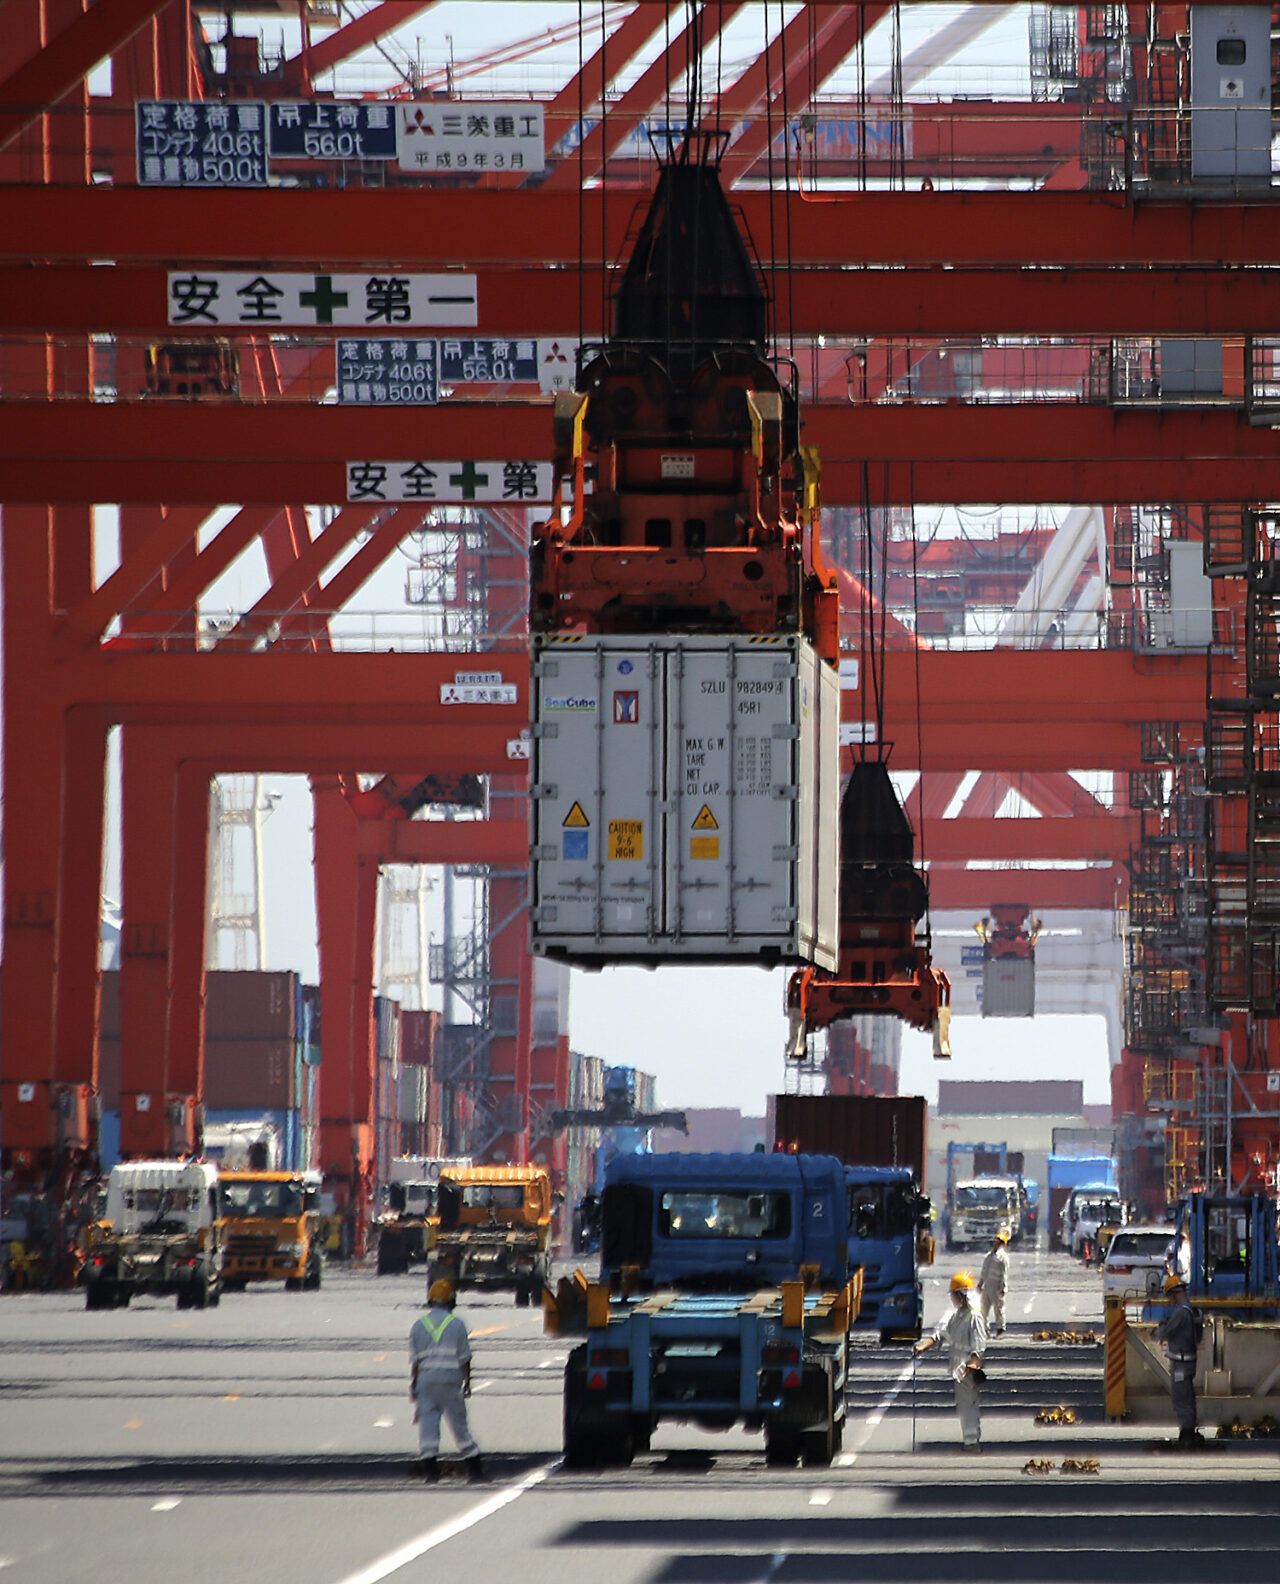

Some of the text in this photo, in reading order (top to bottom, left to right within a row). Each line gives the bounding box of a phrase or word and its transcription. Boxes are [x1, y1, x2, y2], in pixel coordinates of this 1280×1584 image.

[143, 106, 261, 130] 定格荷重
[278, 106, 389, 130] 吊上荷重
[442, 116, 540, 137] 三菱重工
[143, 132, 262, 157] コンテナ 40.6t
[304, 133, 363, 157] 56.0t
[203, 158, 262, 182] 50.0t
[341, 342, 433, 360] 定格荷重
[342, 364, 433, 382] コンテナ 40.6t
[463, 363, 515, 381] 56.0t
[389, 384, 433, 401] 50.0t
[701, 681, 726, 694] SZLU
[545, 697, 596, 708] SeaCube
[737, 701, 761, 714] 45R1
[687, 754, 705, 766] TARE
[609, 822, 642, 834] CAUTION
[616, 847, 634, 858] HIGH
[421, 1161, 440, 1181] 10
[812, 1202, 823, 1217] 2
